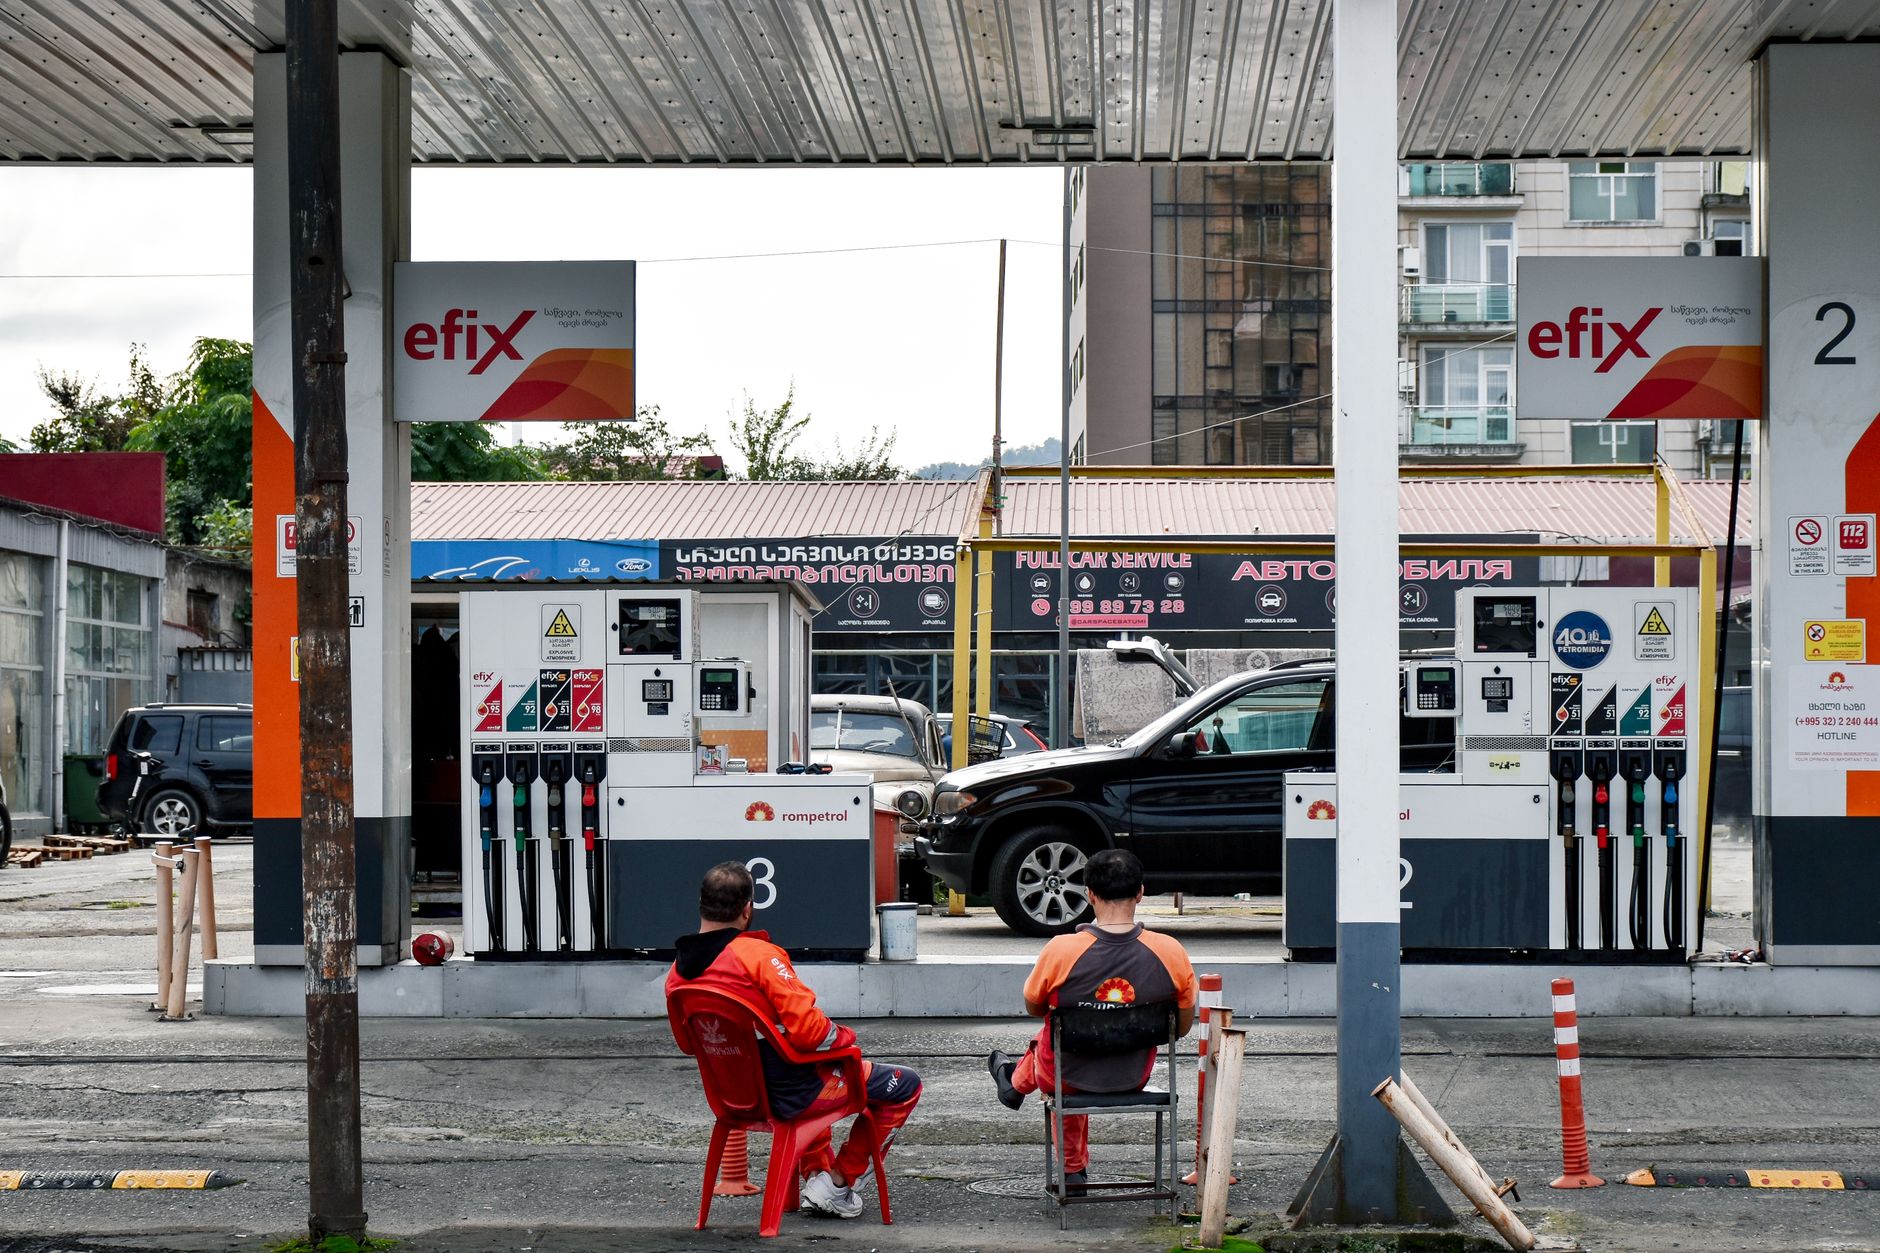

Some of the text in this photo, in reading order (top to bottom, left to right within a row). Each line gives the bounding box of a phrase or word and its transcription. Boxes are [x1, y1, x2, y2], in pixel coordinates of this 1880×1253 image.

[1814, 302, 1856, 365] 2
[404, 309, 537, 375] efix
[1528, 306, 1664, 373] efix
[1842, 525, 1865, 537] 112
[874, 545, 955, 561] თქვენ
[1016, 551, 1192, 569] FULL CAR SERVICE
[623, 561, 645, 571] Ford
[1099, 600, 1125, 614] 89
[1129, 600, 1155, 614] 73
[1160, 600, 1186, 614] 28
[559, 614, 563, 622] 1
[554, 623, 569, 634] EX
[1647, 622, 1662, 632] EX
[473, 671, 494, 683] efix
[1655, 675, 1677, 687] efix
[490, 705, 500, 714] 95
[525, 705, 536, 714] 92
[560, 705, 570, 714] 51
[591, 705, 602, 714] 98
[1809, 702, 1866, 711] ცხელი ხაზი
[1571, 709, 1581, 718] 51
[1606, 709, 1616, 718] 51
[1638, 709, 1650, 718] 92
[1673, 709, 1684, 718] 95
[1795, 717, 1879, 727] (+995 32) 2 240 444
[1817, 732, 1857, 740] HOTLINE
[782, 810, 848, 825] rompetrol
[745, 857, 777, 910] 3
[770, 957, 793, 982] efix
